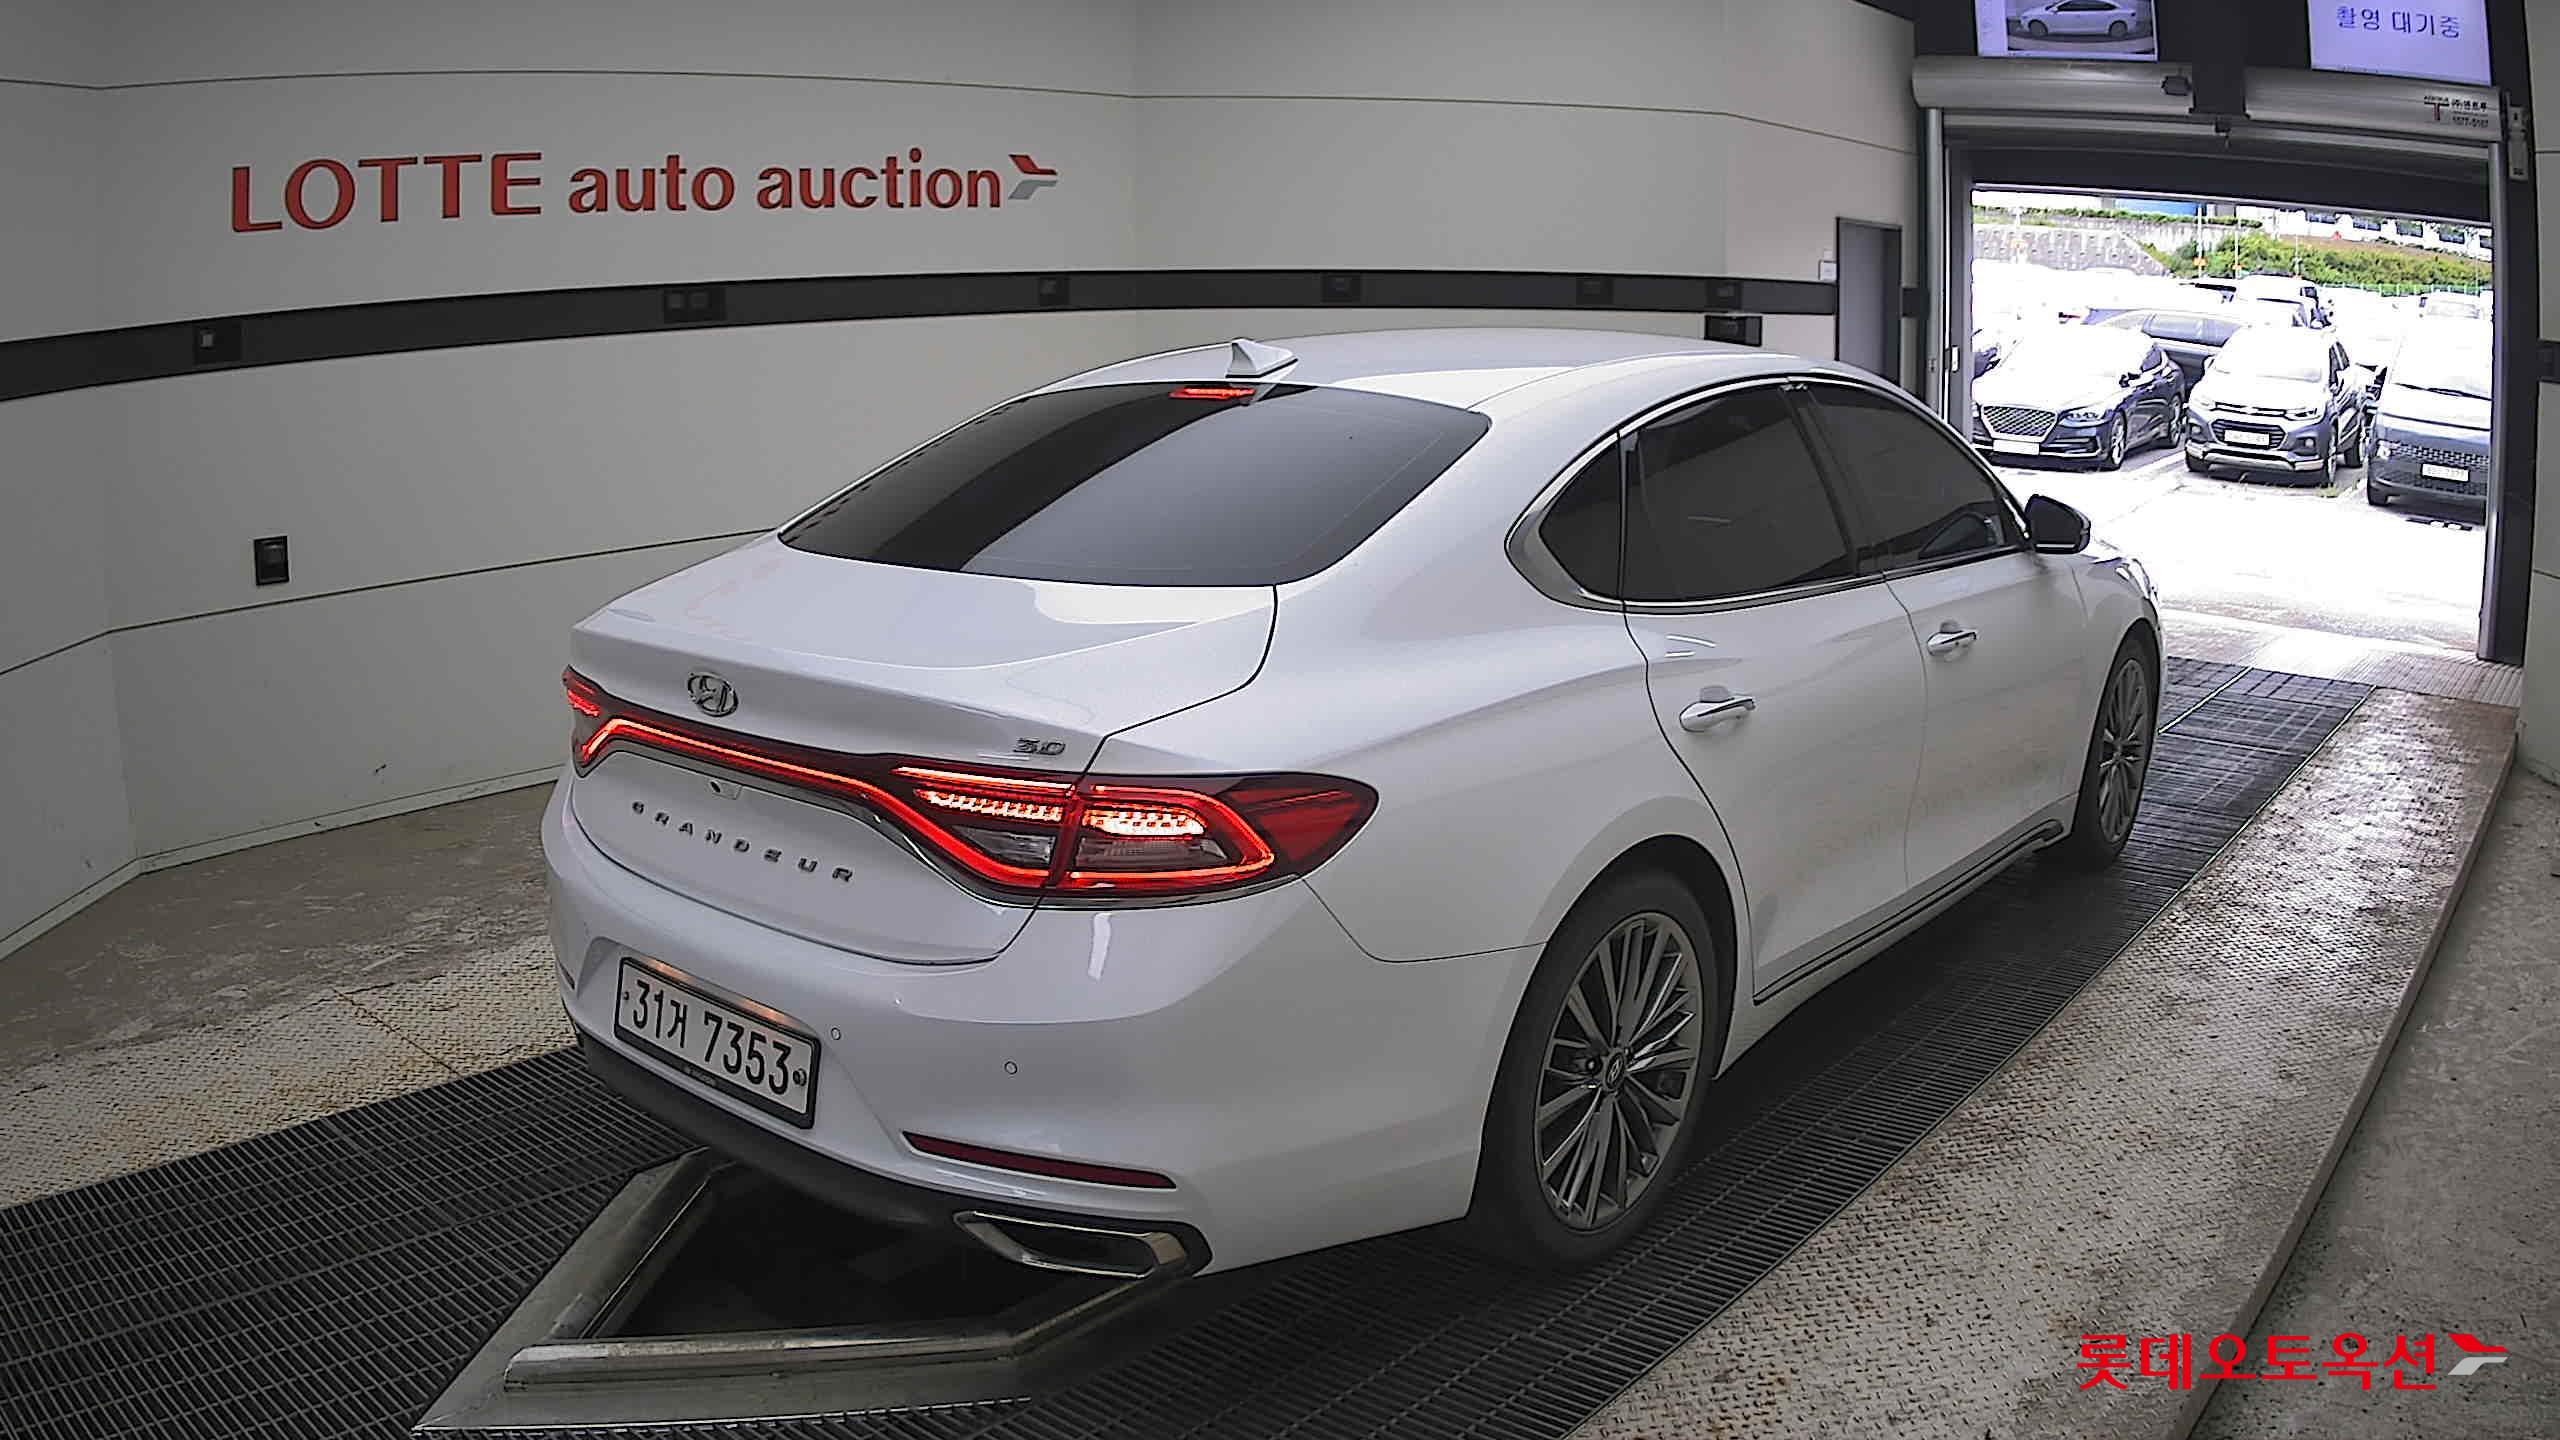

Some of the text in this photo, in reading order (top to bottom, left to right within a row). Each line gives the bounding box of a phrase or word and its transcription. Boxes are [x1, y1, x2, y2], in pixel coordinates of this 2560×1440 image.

[2336, 6, 2461, 39] 촬영 대기중
[231, 148, 1002, 233] LOTTE auto auction
[631, 800, 854, 883] GRANDEUR
[632, 979, 792, 1095] 31거 7353
